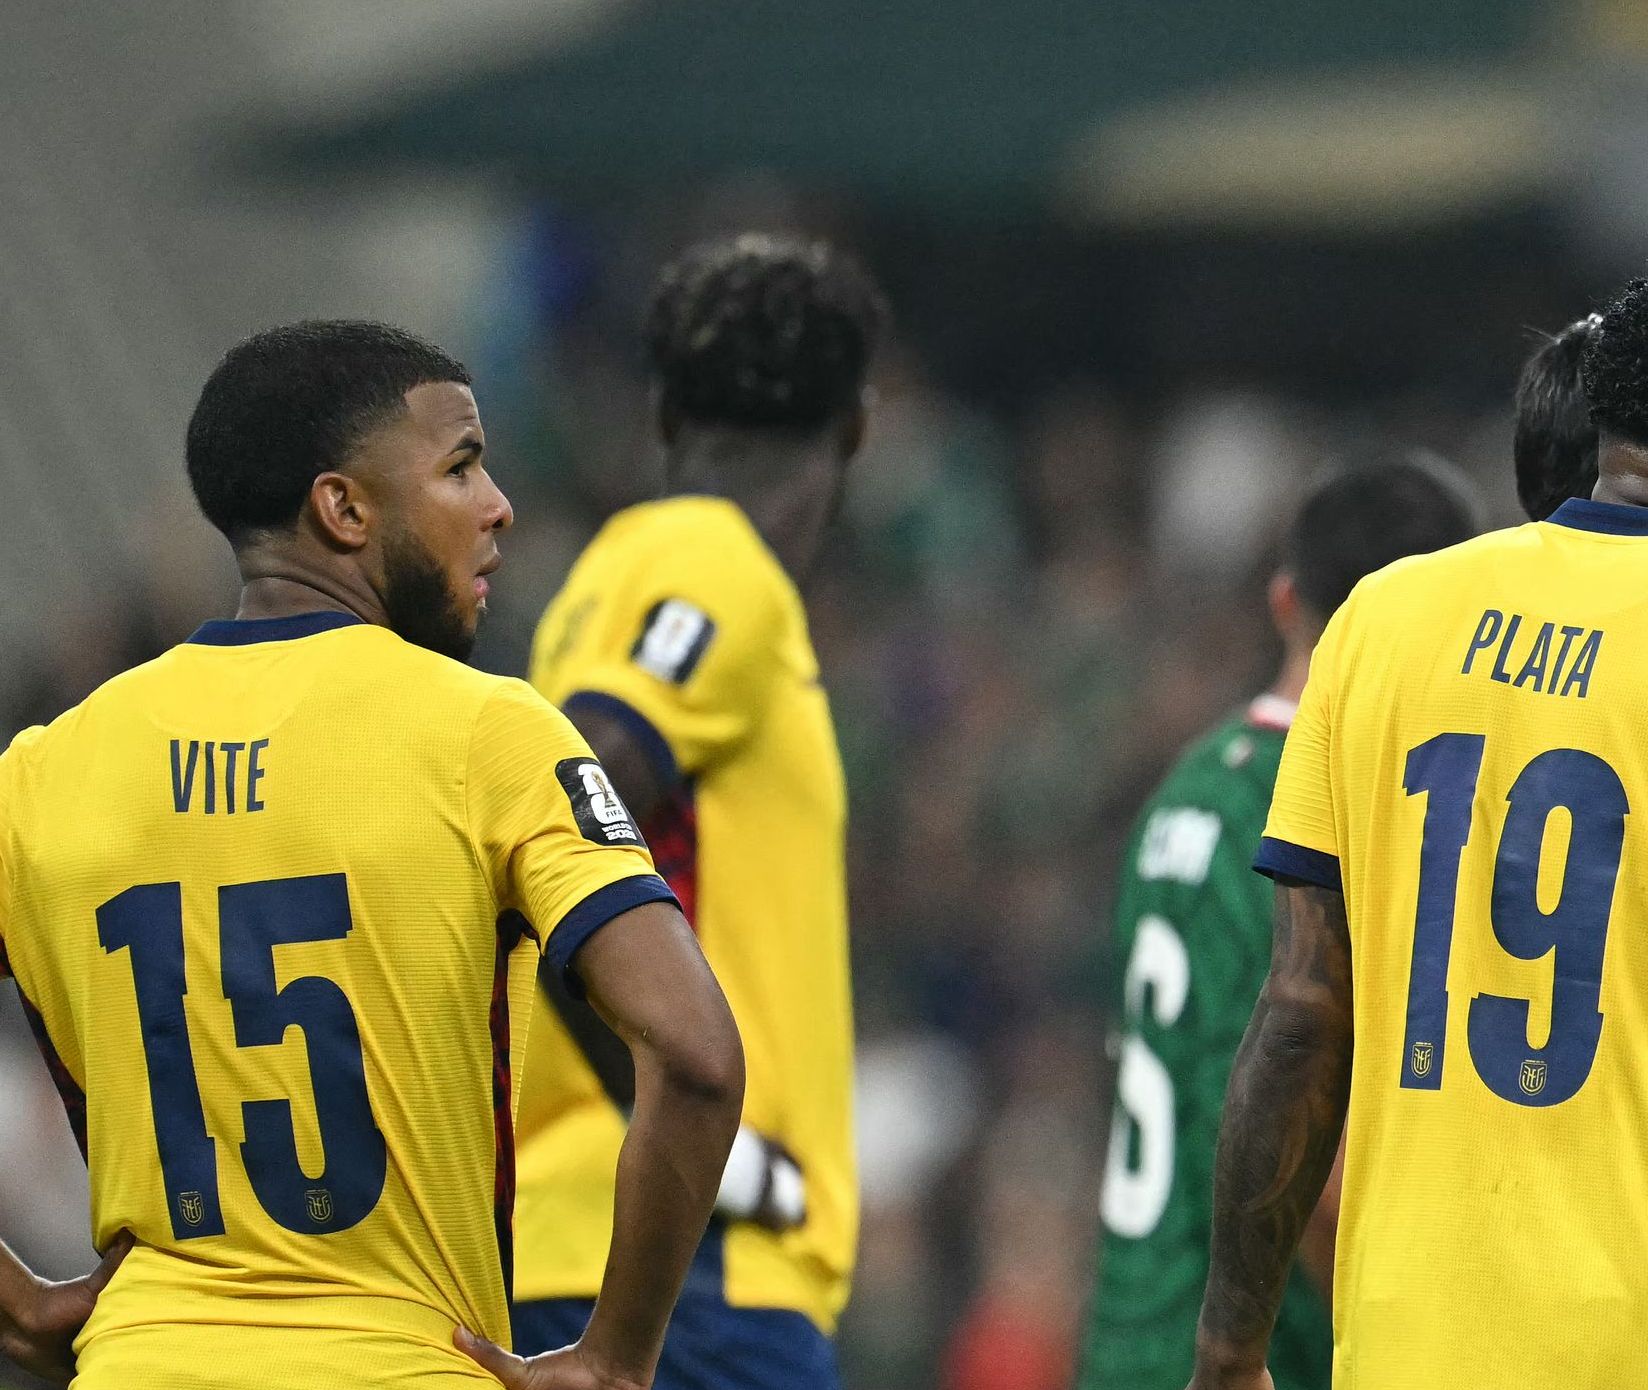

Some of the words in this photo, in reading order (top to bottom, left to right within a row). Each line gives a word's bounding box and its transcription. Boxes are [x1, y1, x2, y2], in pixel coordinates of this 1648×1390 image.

[1460, 609, 1605, 700] PLATA
[169, 737, 270, 814] VITE
[1399, 731, 1630, 1108] 19
[95, 872, 388, 1241] 15
